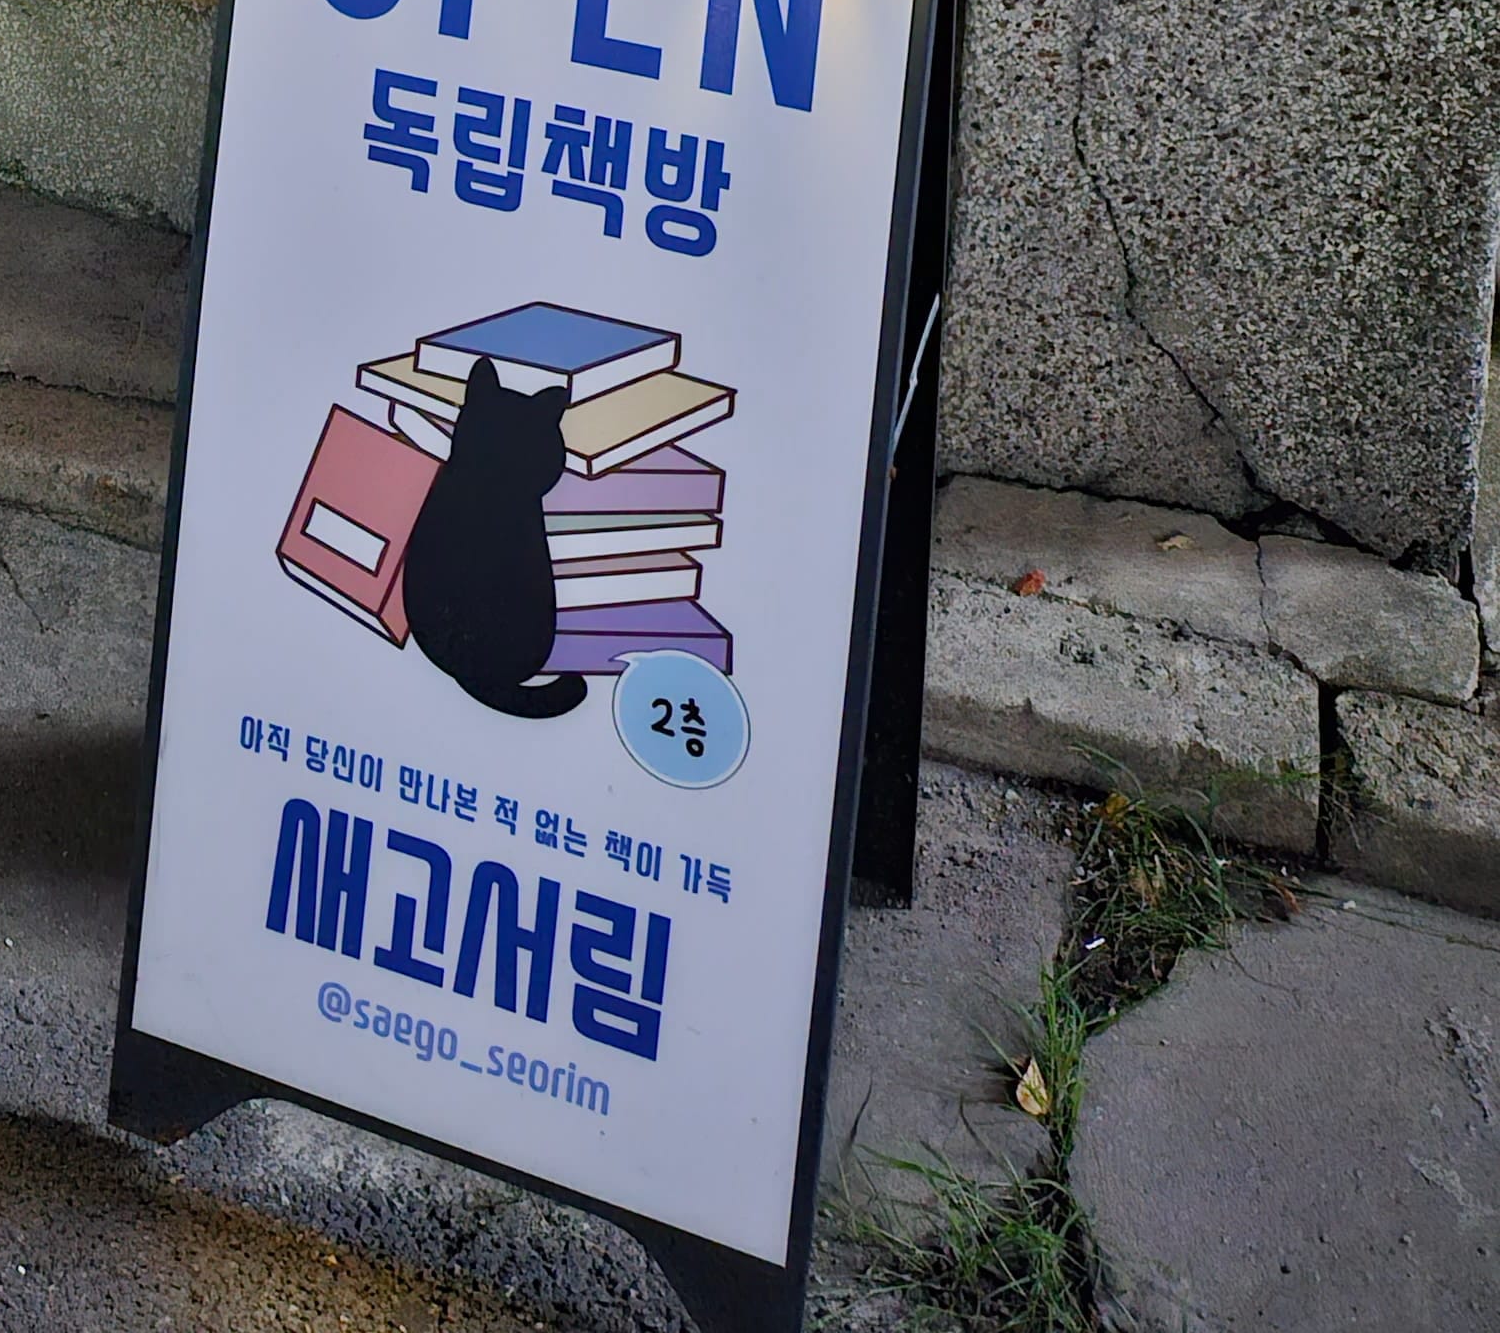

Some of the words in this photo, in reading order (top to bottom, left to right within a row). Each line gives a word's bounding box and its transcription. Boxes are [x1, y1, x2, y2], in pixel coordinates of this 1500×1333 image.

[363, 68, 732, 258] 독립책방
[239, 715, 291, 762] 아직
[305, 734, 383, 793] 당신이
[398, 764, 479, 823] 만나본
[493, 794, 520, 836] 적
[535, 808, 589, 858] 없는
[604, 829, 663, 882] 책이
[679, 853, 733, 904] 가득
[650, 698, 708, 758] 2층
[265, 797, 672, 1063] 새고서림
[316, 981, 612, 1116] @saego_seorim
